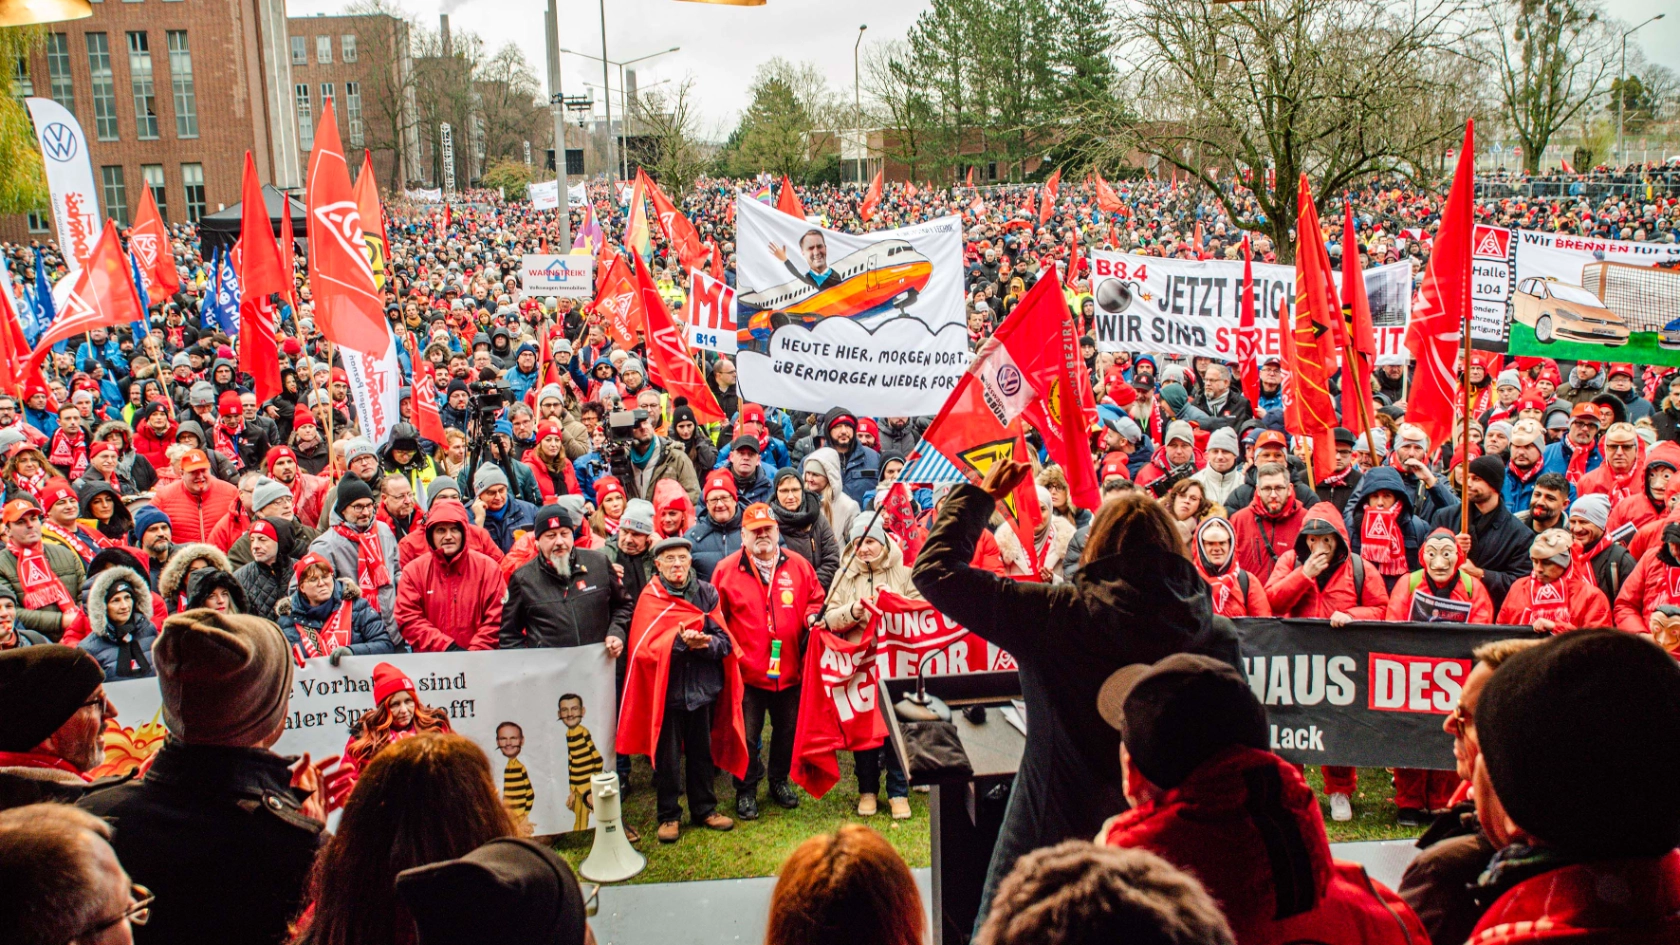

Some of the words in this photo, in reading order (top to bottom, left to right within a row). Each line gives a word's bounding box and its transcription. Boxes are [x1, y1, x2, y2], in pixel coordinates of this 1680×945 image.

[528, 269, 586, 277] WARNSTREIK!
[1096, 258, 1148, 283] B8.4
[1472, 266, 1506, 278] Halle
[1158, 274, 1228, 318] JETZT
[1476, 283, 1501, 295] 104
[1473, 305, 1499, 314] onder-
[696, 332, 717, 347] B14
[1096, 314, 1143, 342] WIR
[1151, 316, 1207, 347] SIND
[781, 337, 831, 357] HEUTE
[836, 344, 873, 363] HIER,
[878, 350, 931, 366] MORGEN
[881, 374, 928, 390] WIEDER
[418, 671, 467, 692] sind
[1243, 654, 1357, 706] HAUS
[1374, 658, 1463, 711] DES
[1269, 724, 1325, 752] Lack
